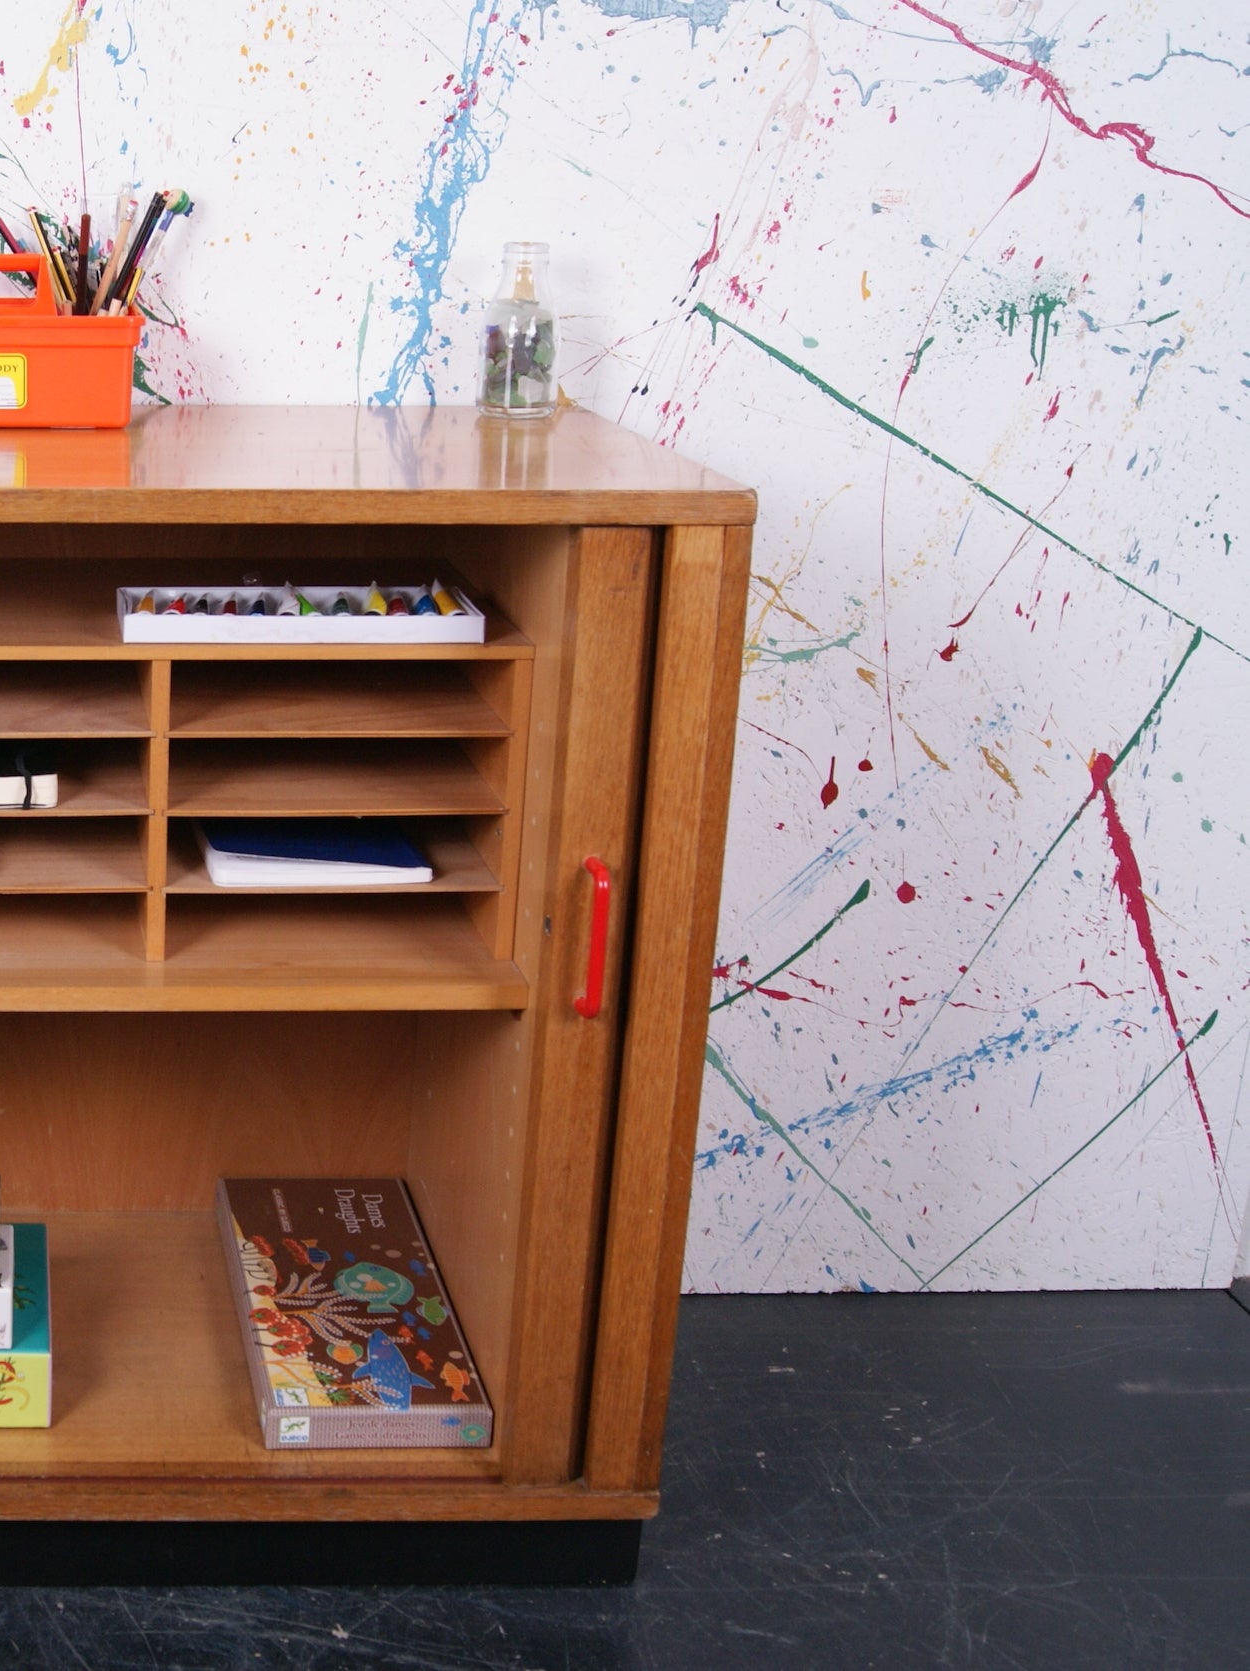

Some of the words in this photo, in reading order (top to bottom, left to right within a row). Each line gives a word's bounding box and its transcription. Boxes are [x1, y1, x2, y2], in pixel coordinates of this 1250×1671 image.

[334, 1189, 366, 1234] Draughts
[362, 1194, 386, 1228] Dames
[335, 1432, 364, 1440] Game
[368, 1431, 379, 1440] of
[382, 1431, 428, 1441] draughts
